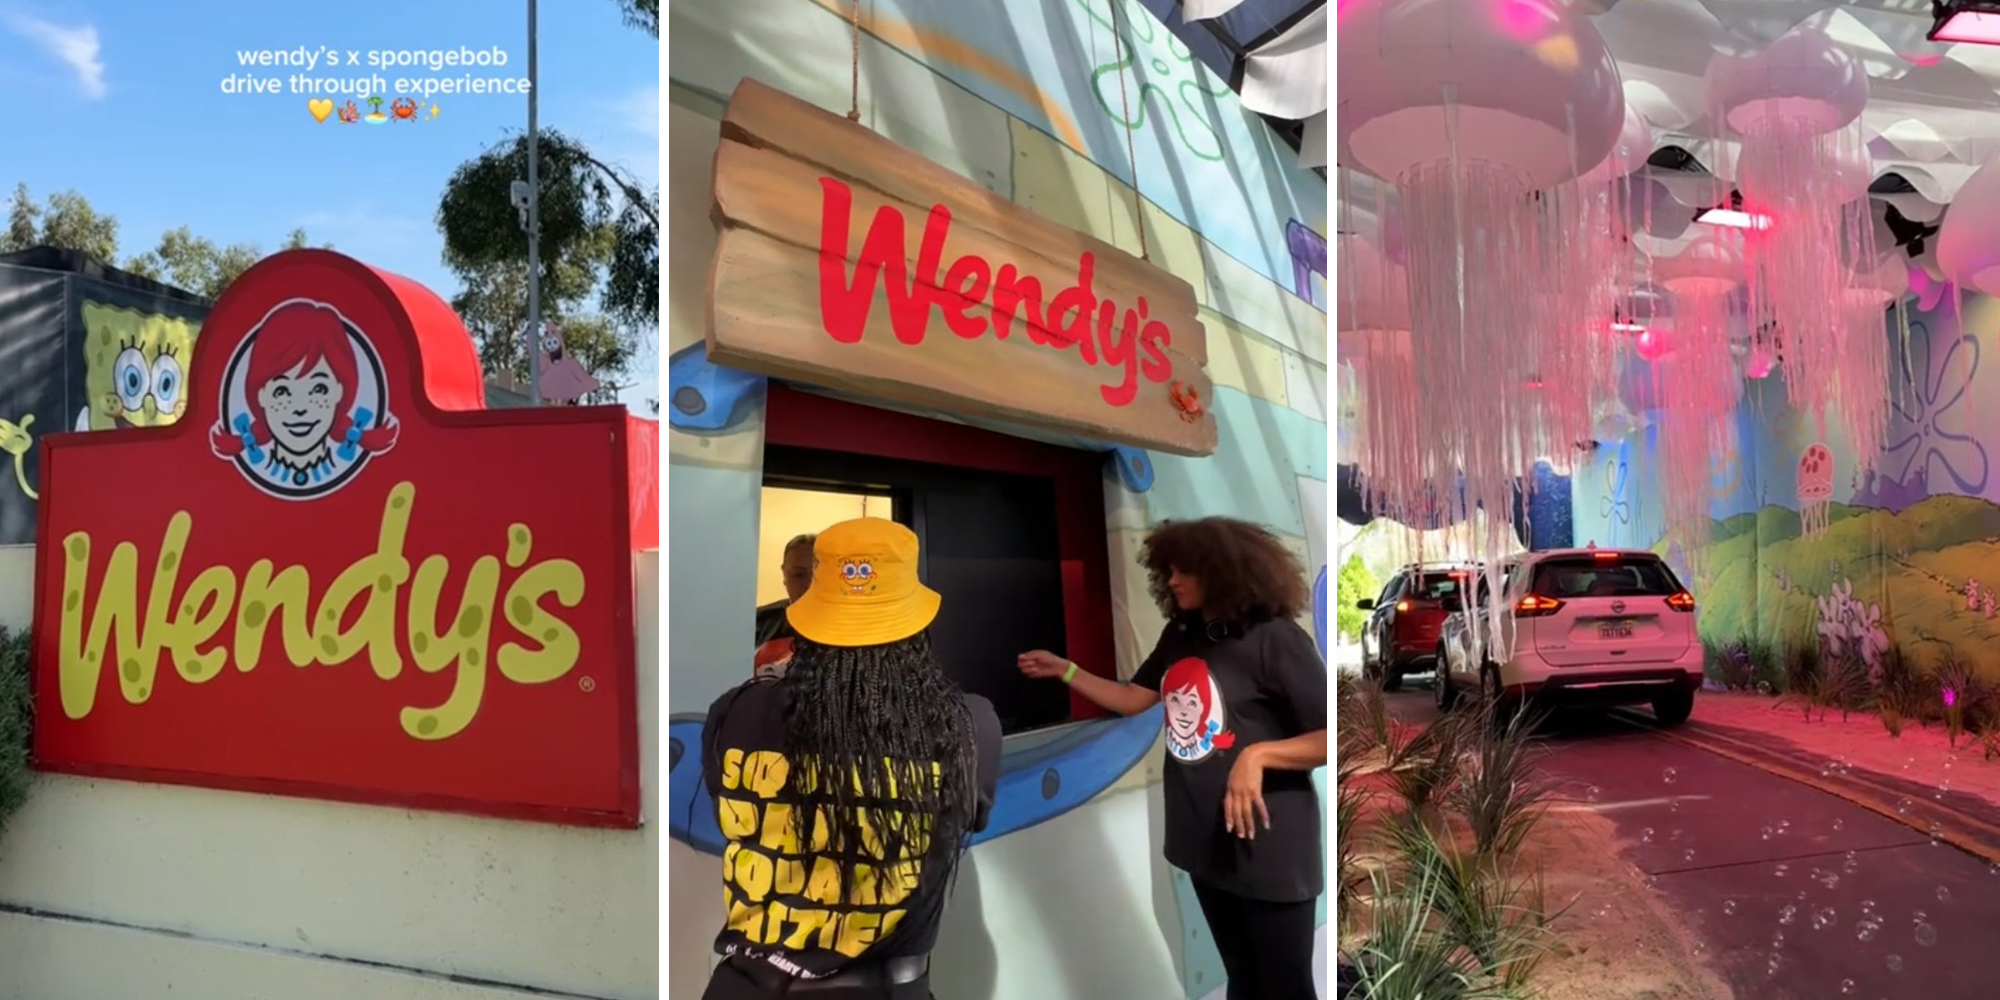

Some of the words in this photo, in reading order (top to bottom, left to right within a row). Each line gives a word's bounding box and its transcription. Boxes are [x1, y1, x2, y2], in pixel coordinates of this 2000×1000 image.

[818, 176, 1172, 407] Wendy's
[59, 481, 585, 740] Wendy's
[724, 885, 908, 958] ATTIE
